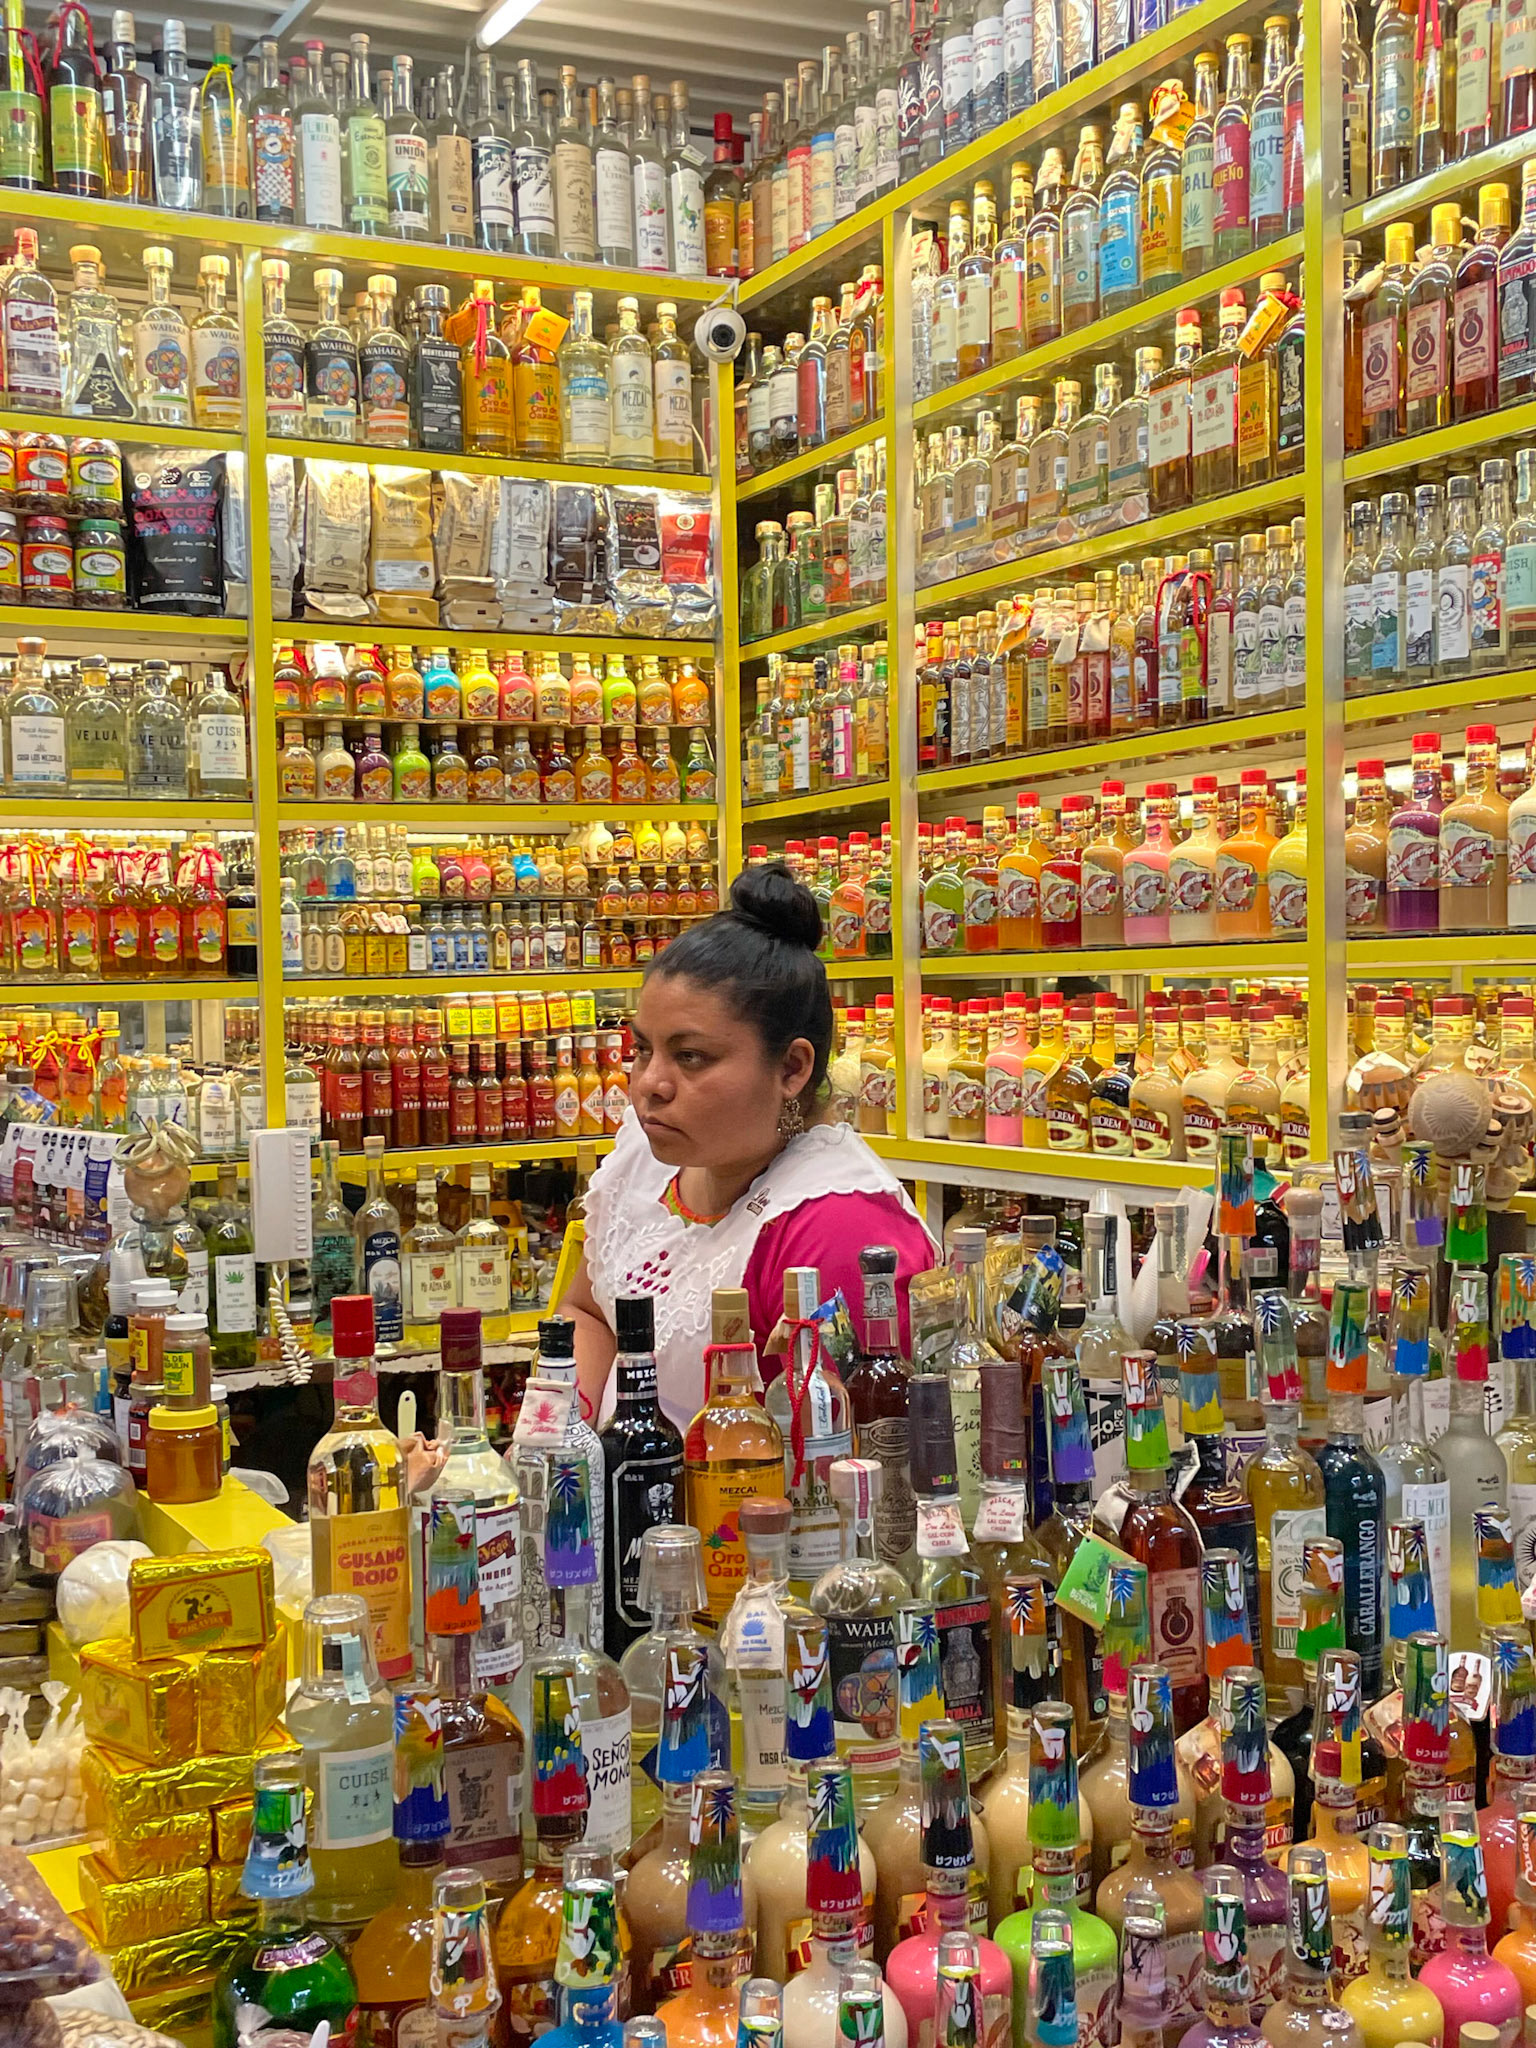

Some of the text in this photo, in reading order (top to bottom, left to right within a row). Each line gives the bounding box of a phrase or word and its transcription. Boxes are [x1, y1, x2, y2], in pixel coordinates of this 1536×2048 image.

[1252, 137, 1284, 160] YOTE
[149, 322, 186, 335] WAHAKA
[264, 333, 300, 347] WAHAKA
[320, 341, 356, 353] WAHAKA
[365, 347, 402, 358] WAHAKA
[622, 389, 647, 407] MEZCAL
[206, 724, 242, 737] CUISH
[173, 1354, 184, 1363] DE
[627, 1366, 656, 1380] MEZC
[954, 1415, 982, 1433] Esen
[719, 1485, 758, 1495] MEZCAL
[337, 1546, 406, 1571] GUSANO
[712, 1550, 745, 1564] Oro
[1278, 1556, 1303, 1565] AGAV
[708, 1563, 748, 1578] Oax
[1359, 1518, 1377, 1637] CABALLERANGO
[352, 1569, 400, 1588] ROJO
[846, 1619, 893, 1637] WAHA
[866, 1638, 894, 1648] Mezca
[759, 1703, 785, 1716] Mezc
[592, 1733, 631, 1772] SEÑOR
[759, 1751, 779, 1765] CASA
[339, 1769, 390, 1791] CUISH
[593, 1763, 631, 1791] MONO
